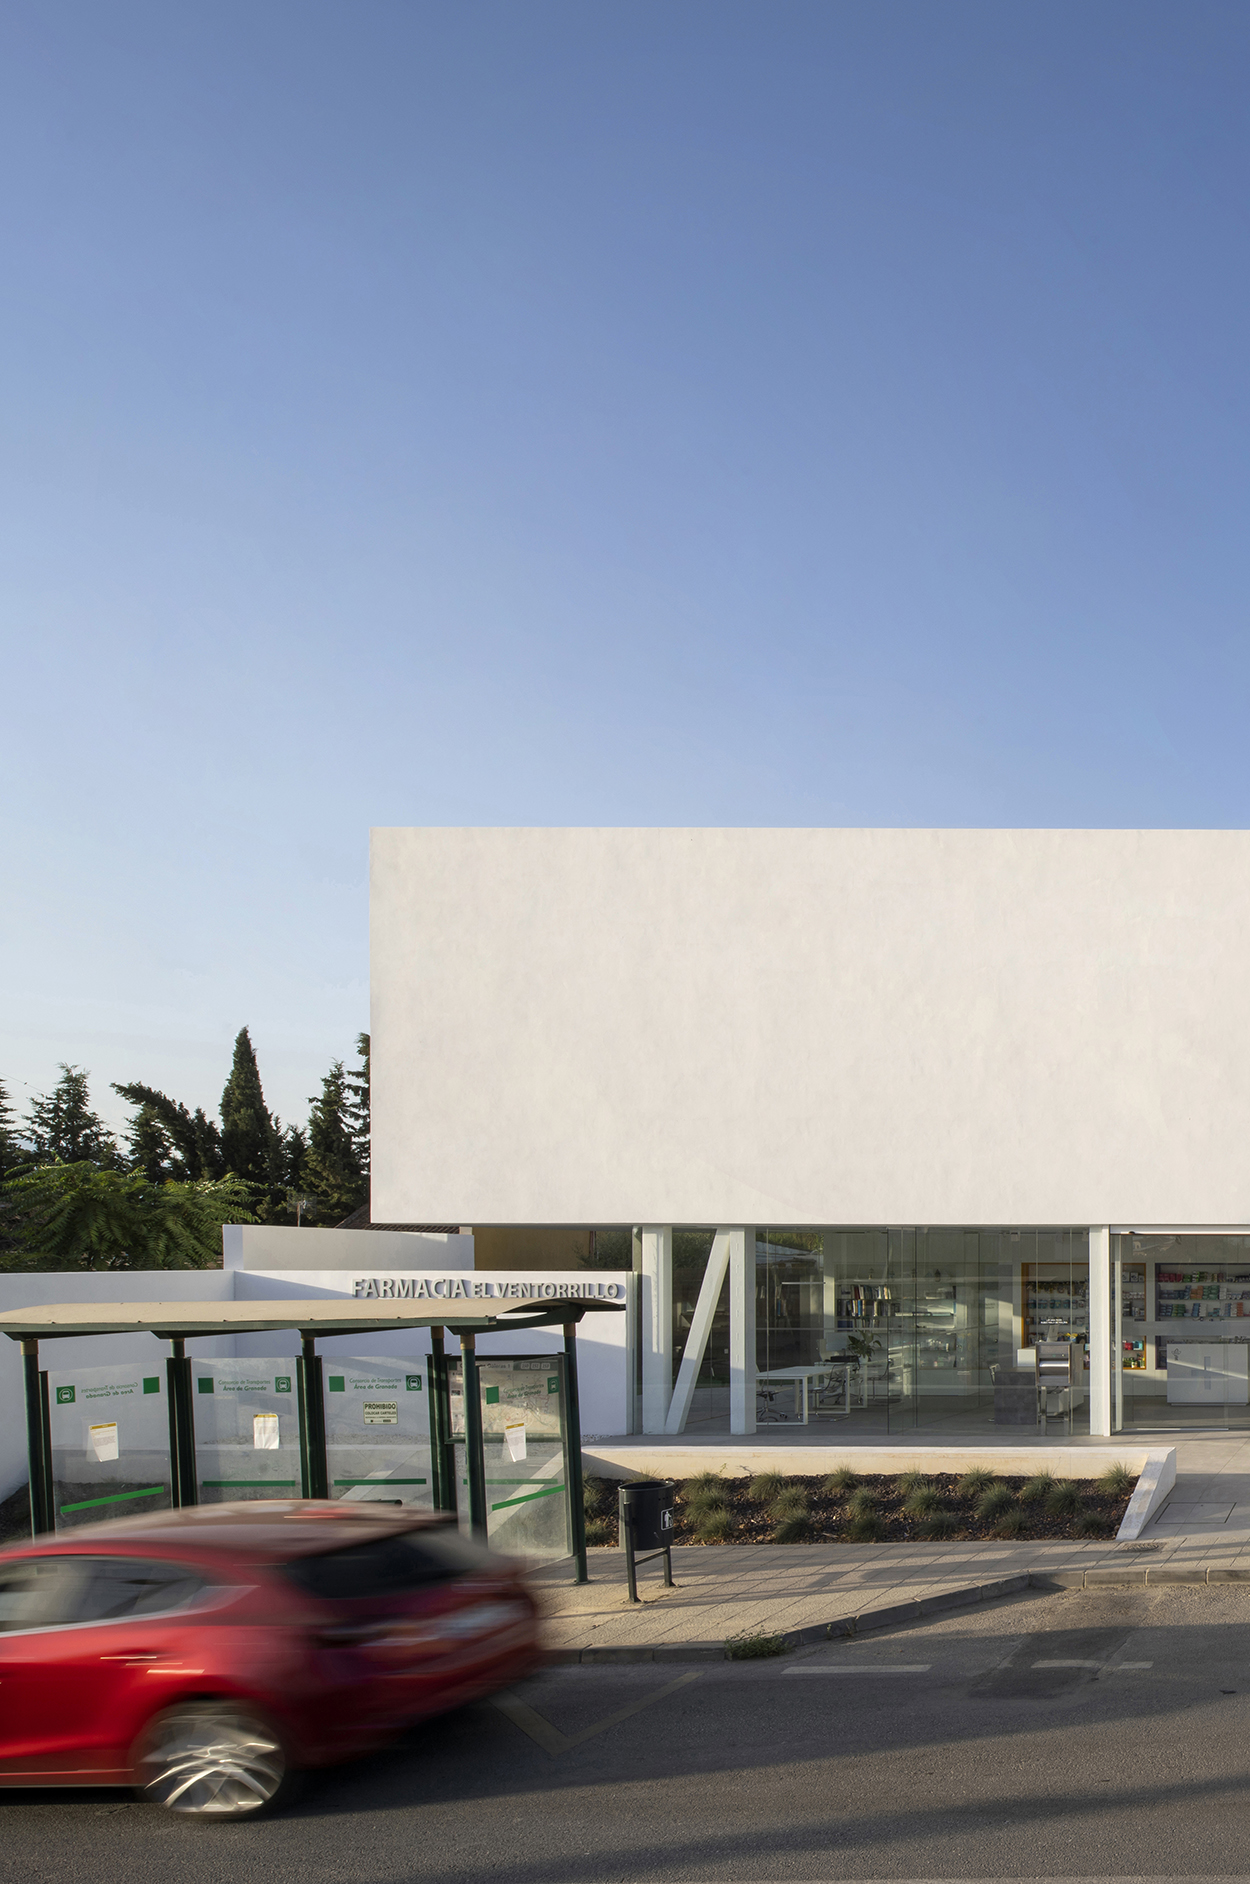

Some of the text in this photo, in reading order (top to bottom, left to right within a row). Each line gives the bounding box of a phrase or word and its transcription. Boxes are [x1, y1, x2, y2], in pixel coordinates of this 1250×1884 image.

[351, 1278, 619, 1299] FARMACIA EL VENTORRILLO
